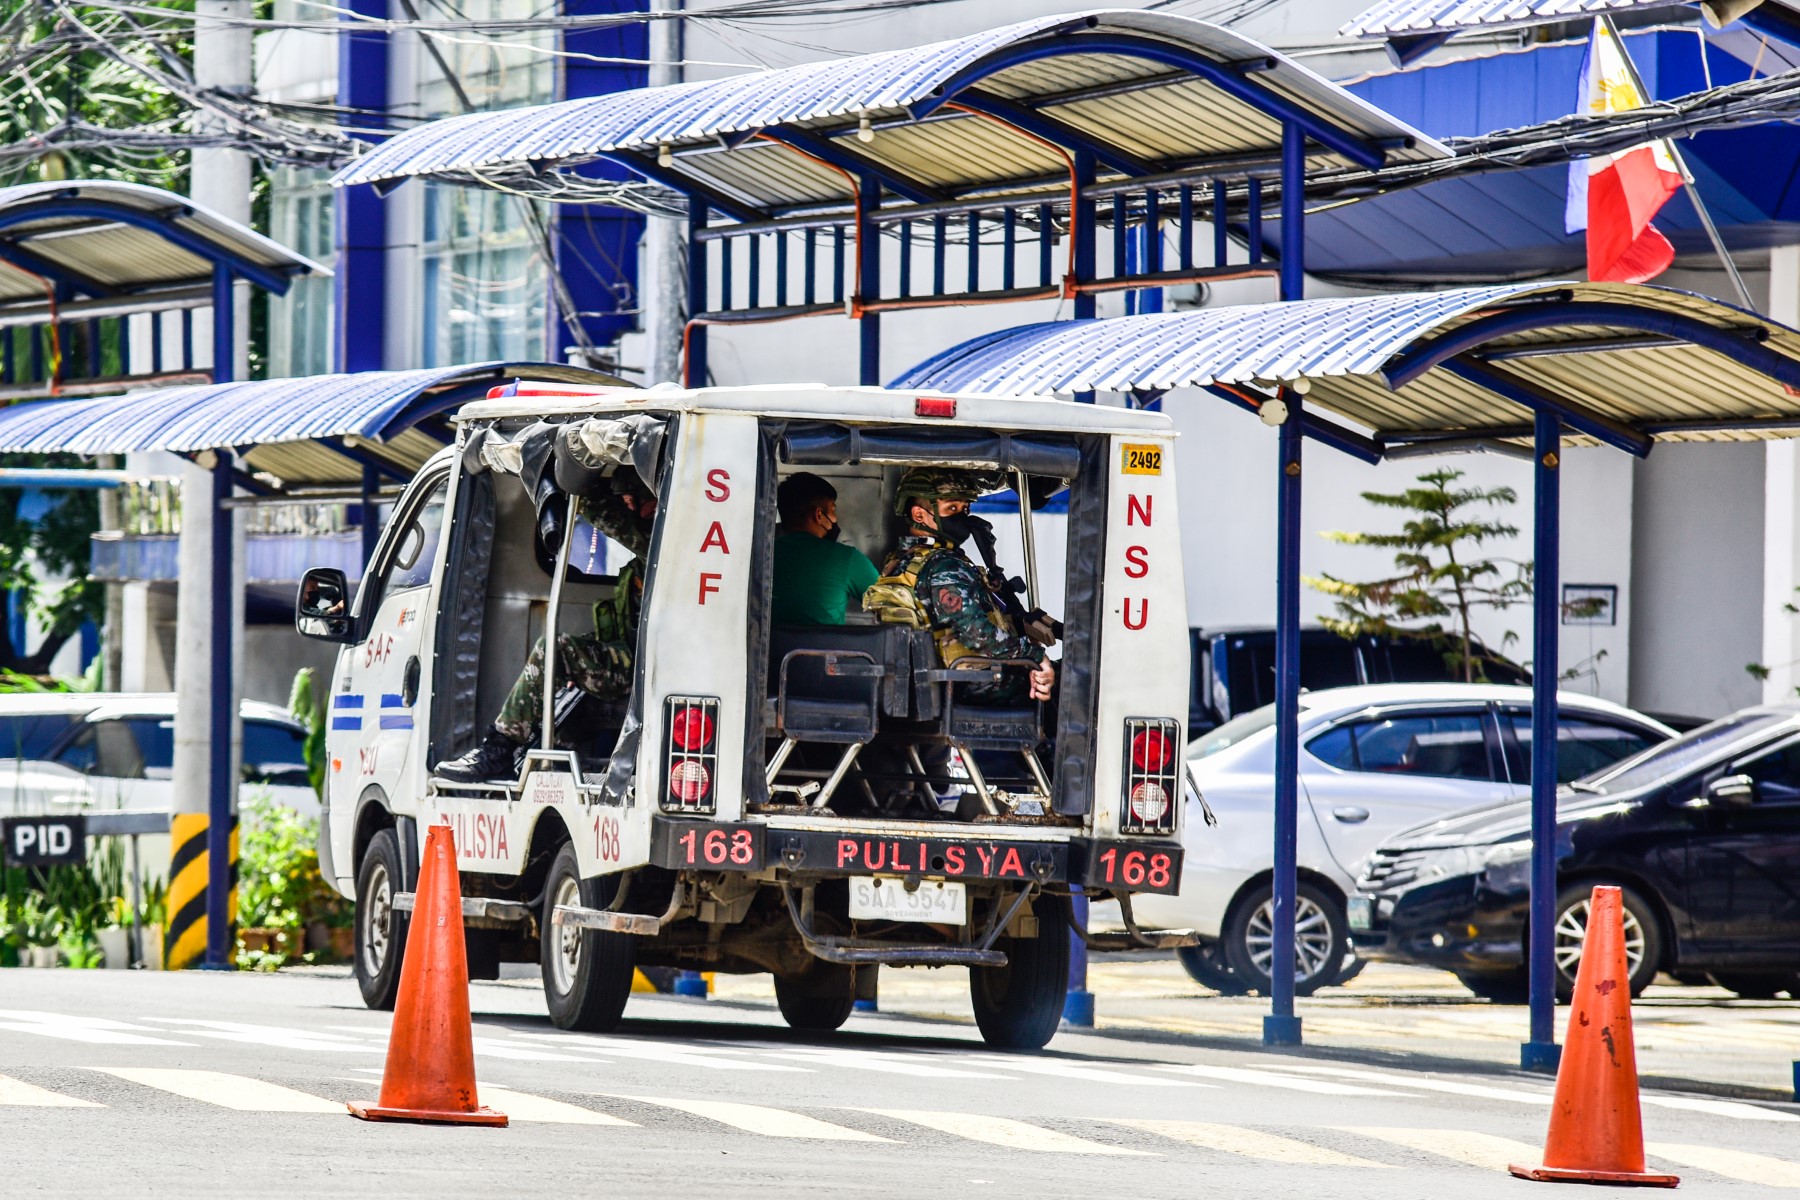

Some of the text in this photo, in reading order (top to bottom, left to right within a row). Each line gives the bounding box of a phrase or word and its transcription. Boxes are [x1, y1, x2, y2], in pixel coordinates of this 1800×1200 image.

[1130, 450, 1161, 470] 2492
[698, 468, 731, 606] SAF
[1123, 493, 1153, 631] NSU
[365, 632, 394, 669] SAF
[14, 824, 72, 857] PID
[440, 812, 509, 860] ULISYA
[593, 814, 621, 862] 168
[679, 828, 755, 866] 168
[836, 839, 1025, 878] PULISYA
[1099, 847, 1173, 889] 168
[857, 884, 960, 912] SAA 5547
[884, 909, 934, 918] GOVERNMENT
